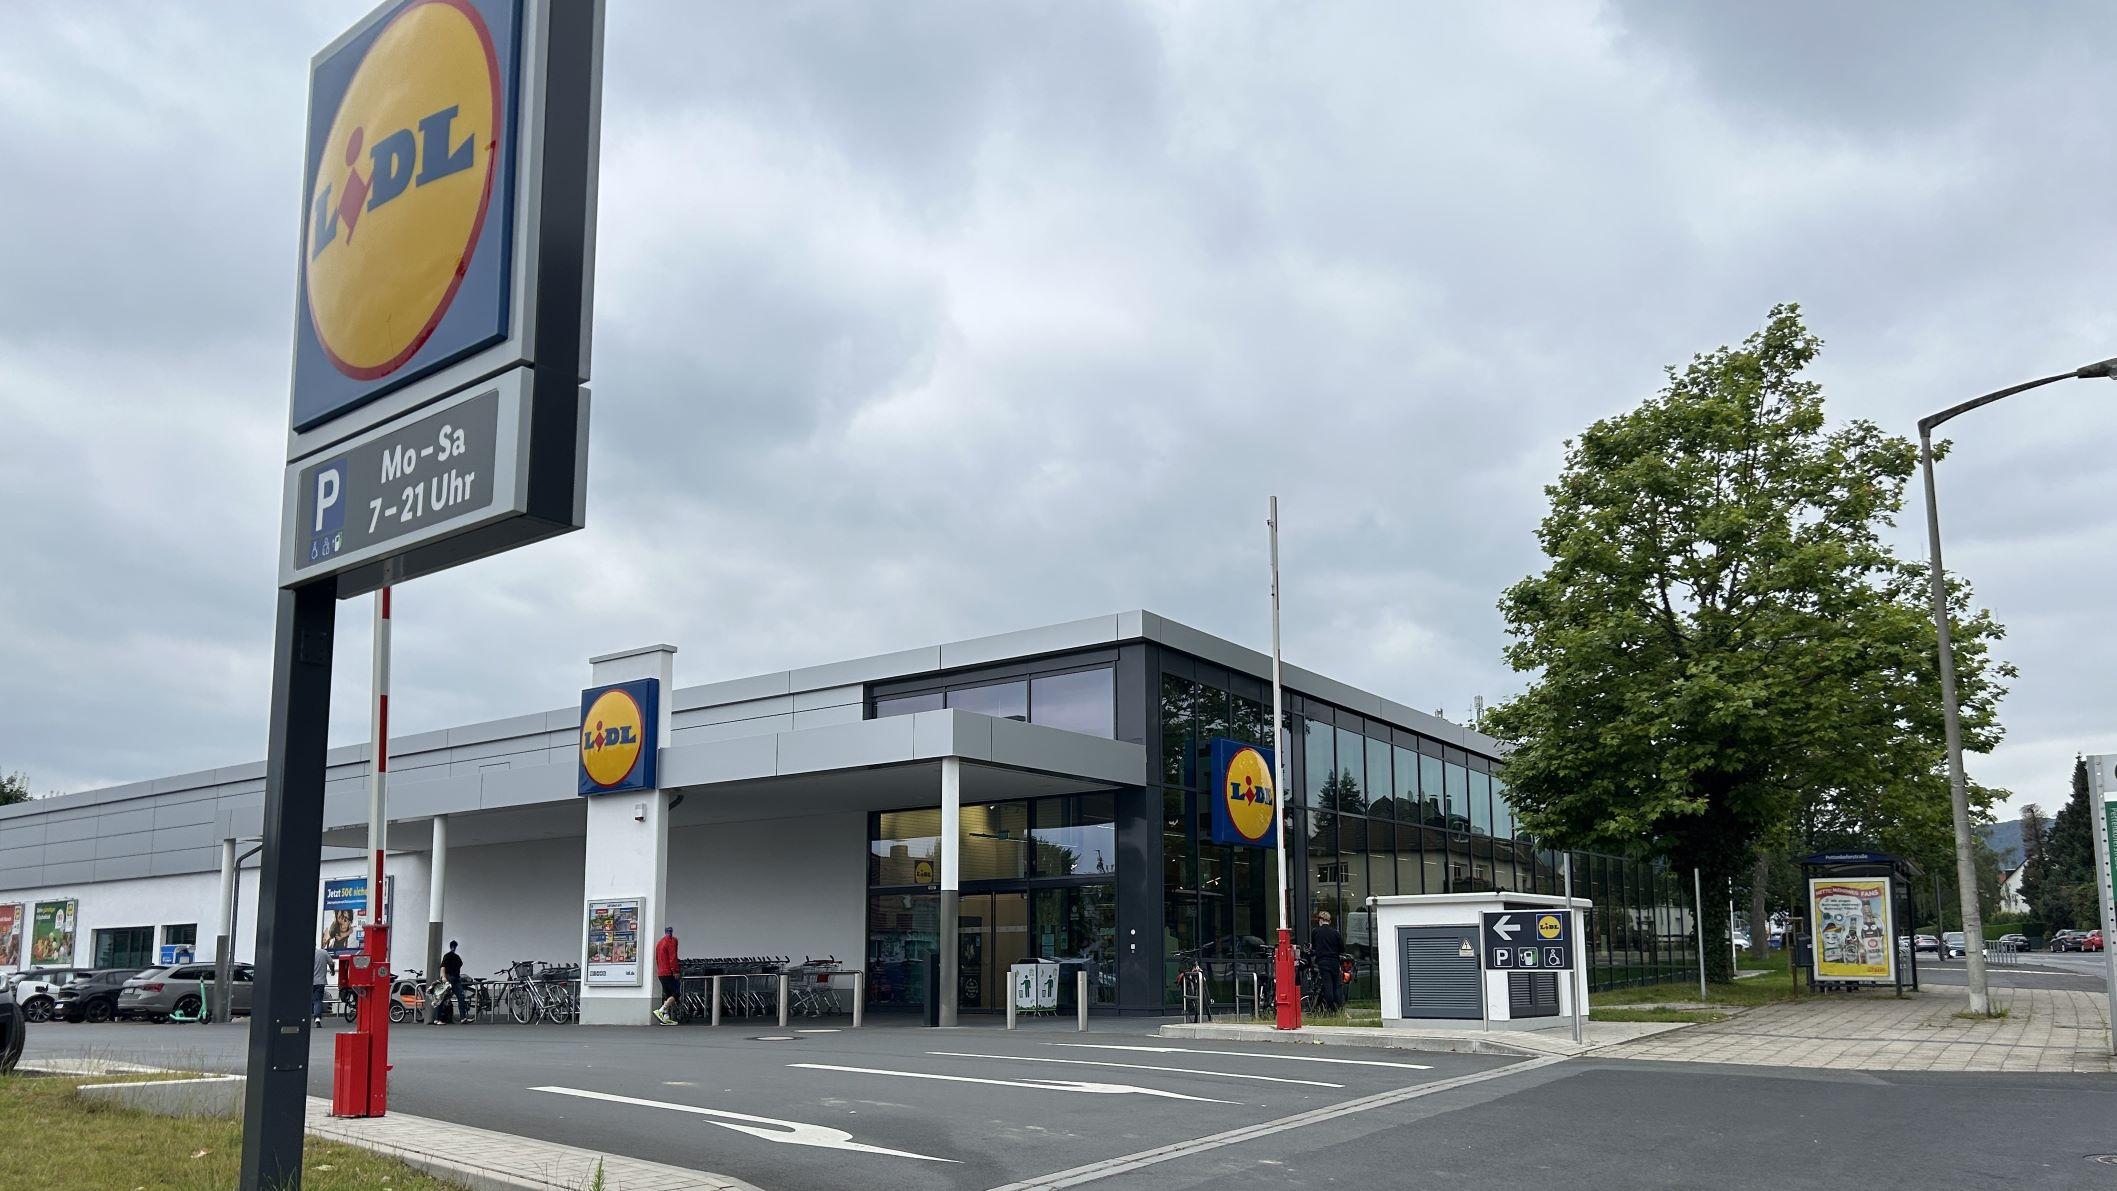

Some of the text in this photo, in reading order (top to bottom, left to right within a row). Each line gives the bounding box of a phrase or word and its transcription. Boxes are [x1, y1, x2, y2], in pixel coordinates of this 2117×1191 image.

[430, 468, 475, 512] Uhr
[327, 888, 341, 898] Jetzt
[1860, 889, 1879, 897] FANS
